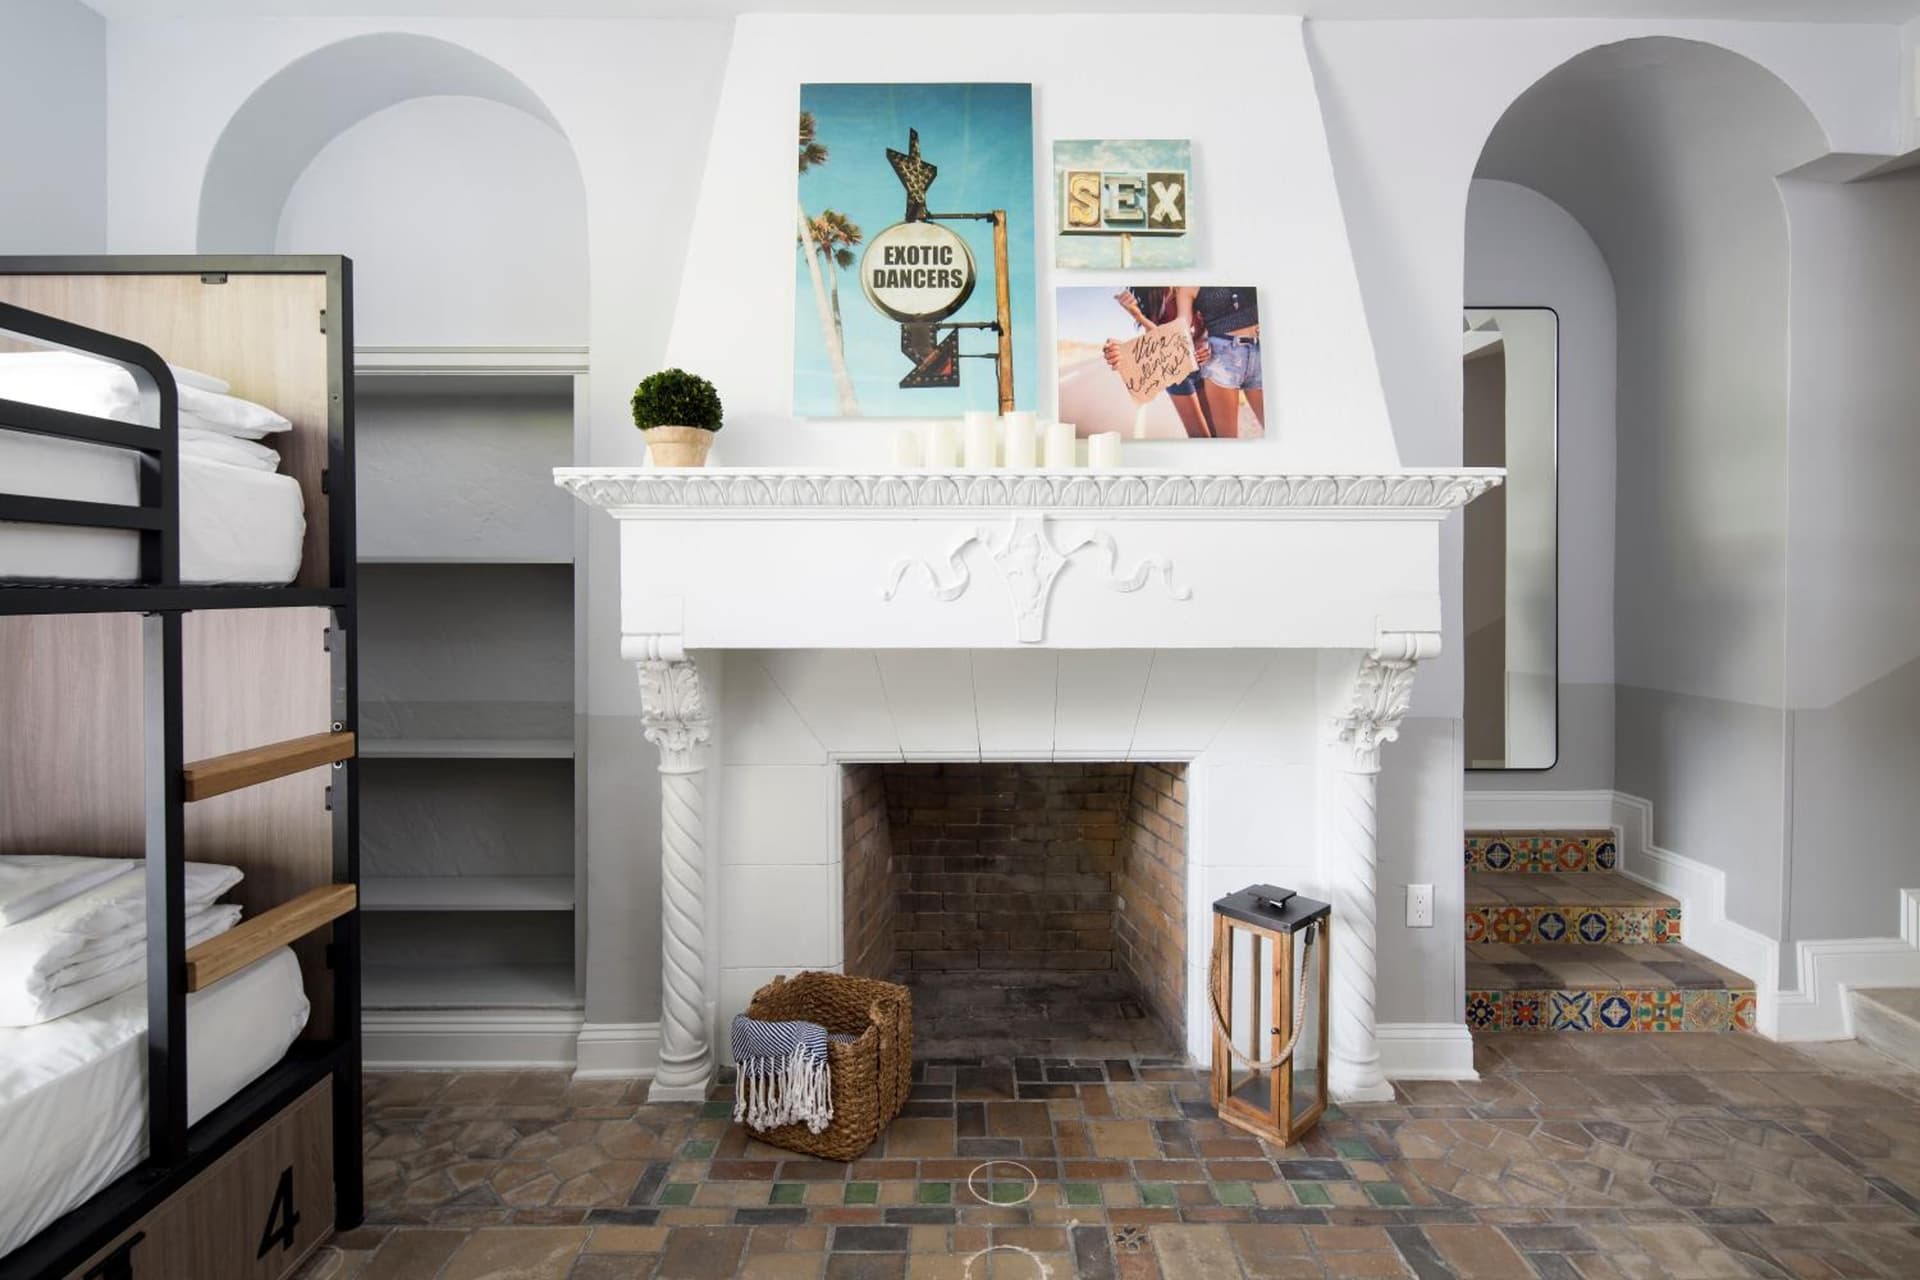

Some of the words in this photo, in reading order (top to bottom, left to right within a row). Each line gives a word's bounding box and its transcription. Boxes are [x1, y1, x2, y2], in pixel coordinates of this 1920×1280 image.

[1069, 174, 1182, 226] SEX
[884, 245, 953, 266] EXOTIC
[873, 269, 963, 289] DANCERS
[256, 1164, 301, 1260] 4
